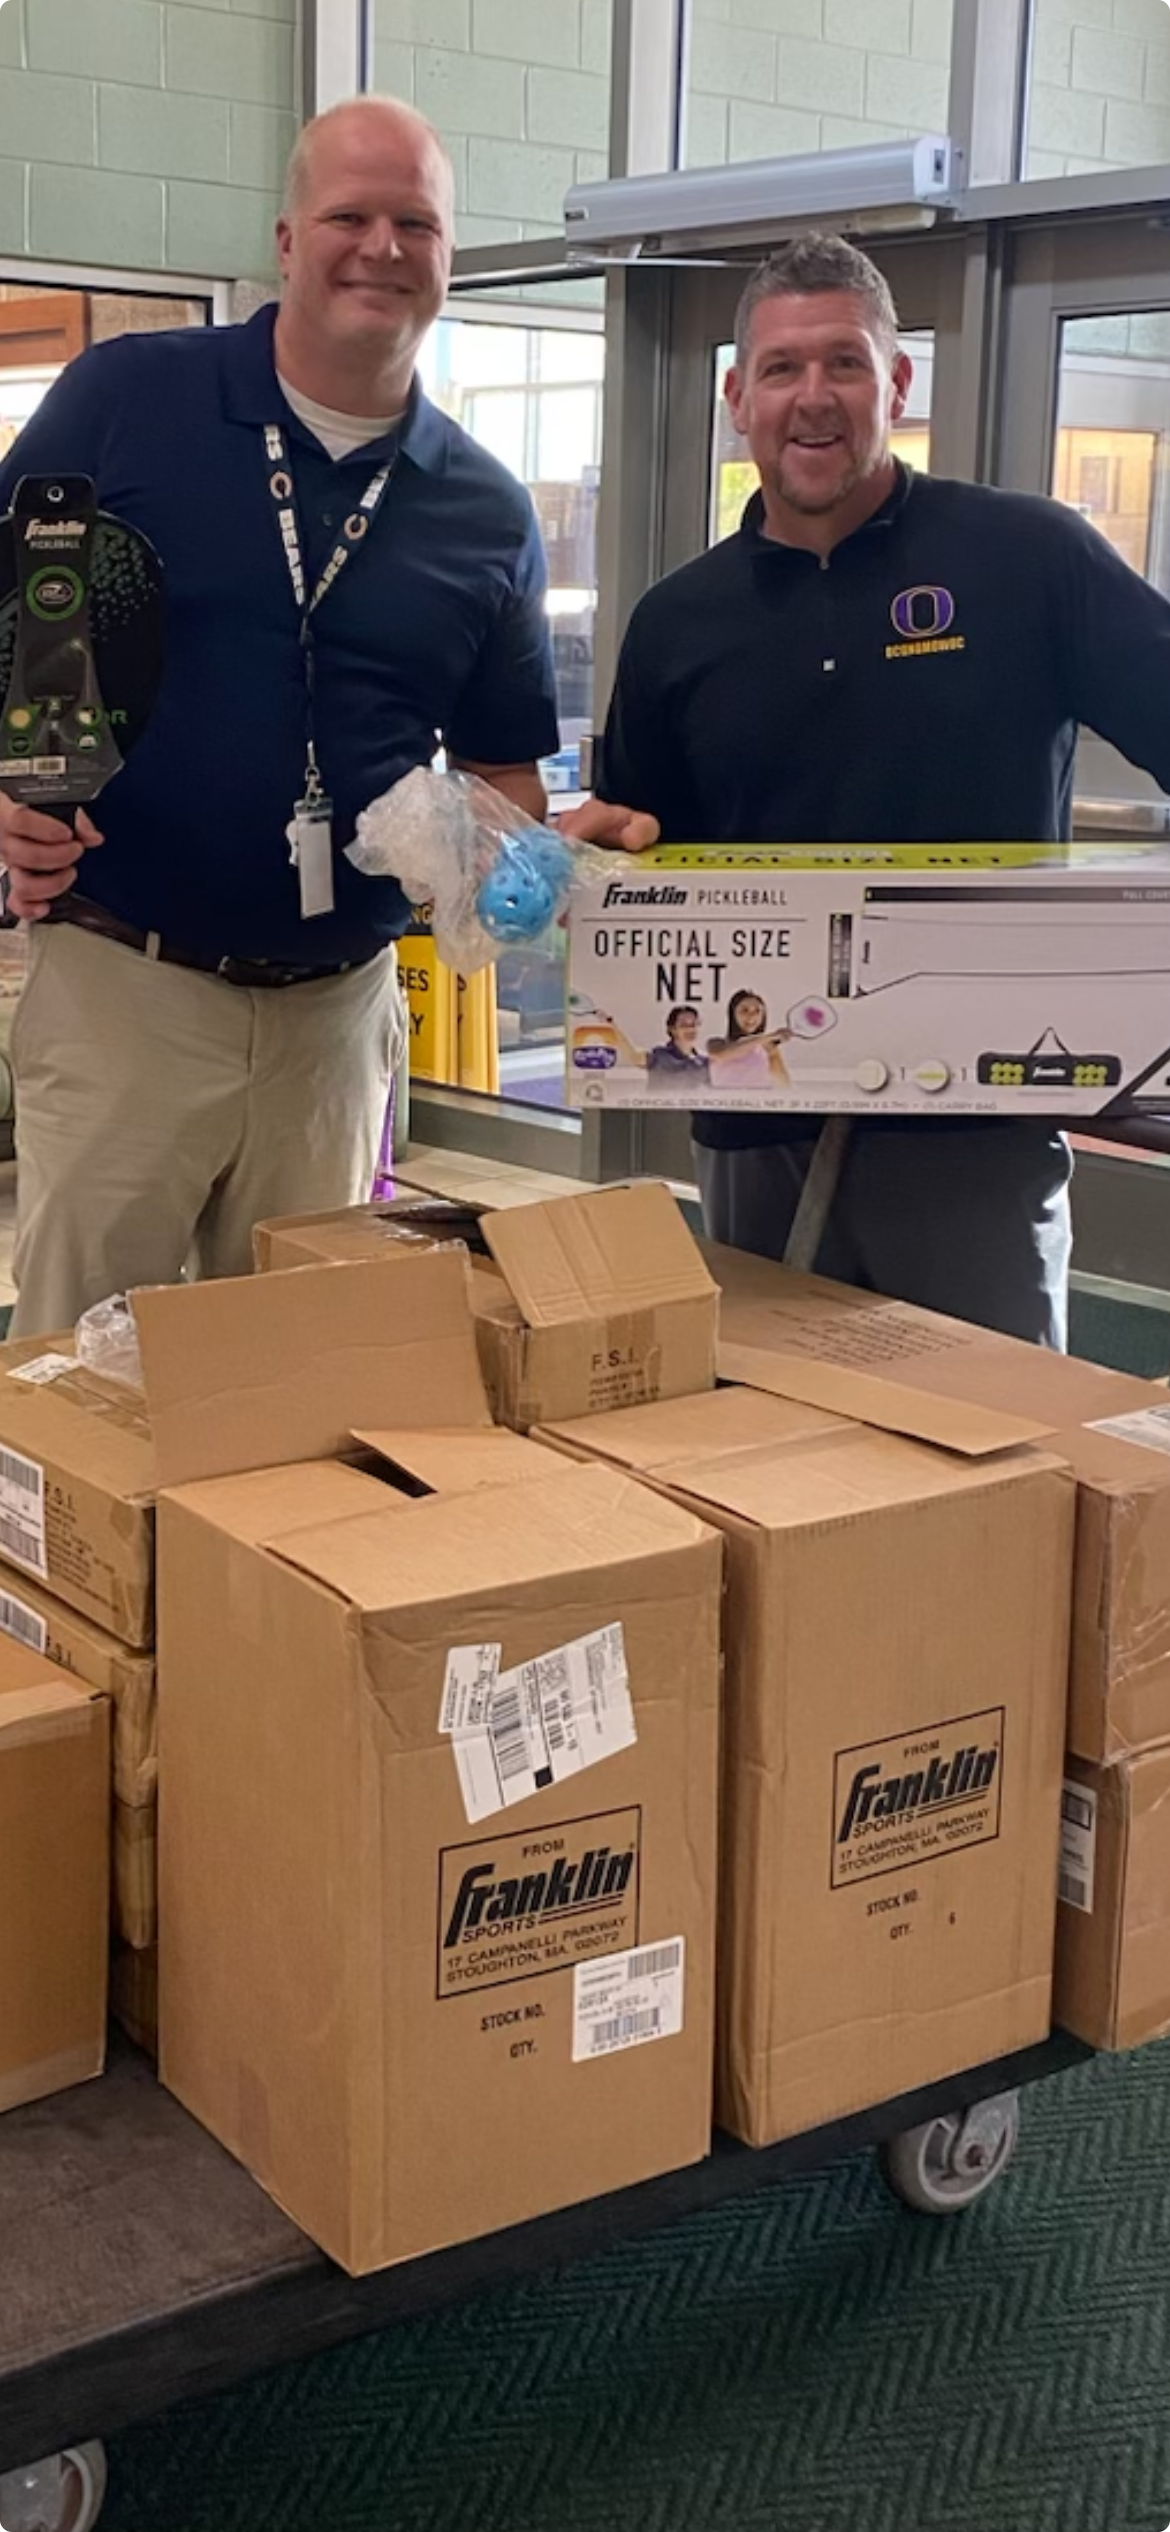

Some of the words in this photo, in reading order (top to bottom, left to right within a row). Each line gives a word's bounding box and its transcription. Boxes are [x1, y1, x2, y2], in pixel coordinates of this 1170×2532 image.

[24, 518, 87, 541] Franklin
[29, 539, 81, 549] PICKLEBALL
[278, 508, 306, 605] BEARS
[890, 585, 954, 639] O
[885, 635, 966, 659] OCONOMOWOC
[602, 883, 689, 909] Franklin
[697, 889, 787, 906] PICKLEBALL
[594, 929, 717, 958] OFFICIAL
[731, 929, 791, 958] SIZE
[656, 962, 728, 1002] NET
[902, 1740, 940, 1759] FROM
[836, 1744, 998, 1844] Franklin
[840, 1849, 852, 1861] 17
[857, 1826, 932, 1857] CAMPANELLI
[935, 1808, 990, 1833] PARKWAY
[851, 1809, 915, 1839] SPORTS
[945, 1822, 984, 1841] 02072
[521, 1838, 565, 1858] FROM
[442, 1846, 634, 1949] Franklin
[865, 1894, 901, 1917] STOCK
[447, 1952, 461, 1969] 17
[467, 1932, 558, 1965] CAMPANELLI
[562, 1915, 628, 1942] PARKWAY
[461, 1914, 537, 1944] SPORTS
[445, 1954, 541, 1983] STOUGHTON,
[573, 1931, 620, 1951] 02072
[479, 2008, 522, 2033] STOCK
[524, 2002, 546, 2021] NO.
[509, 2038, 539, 2059] QTY.
